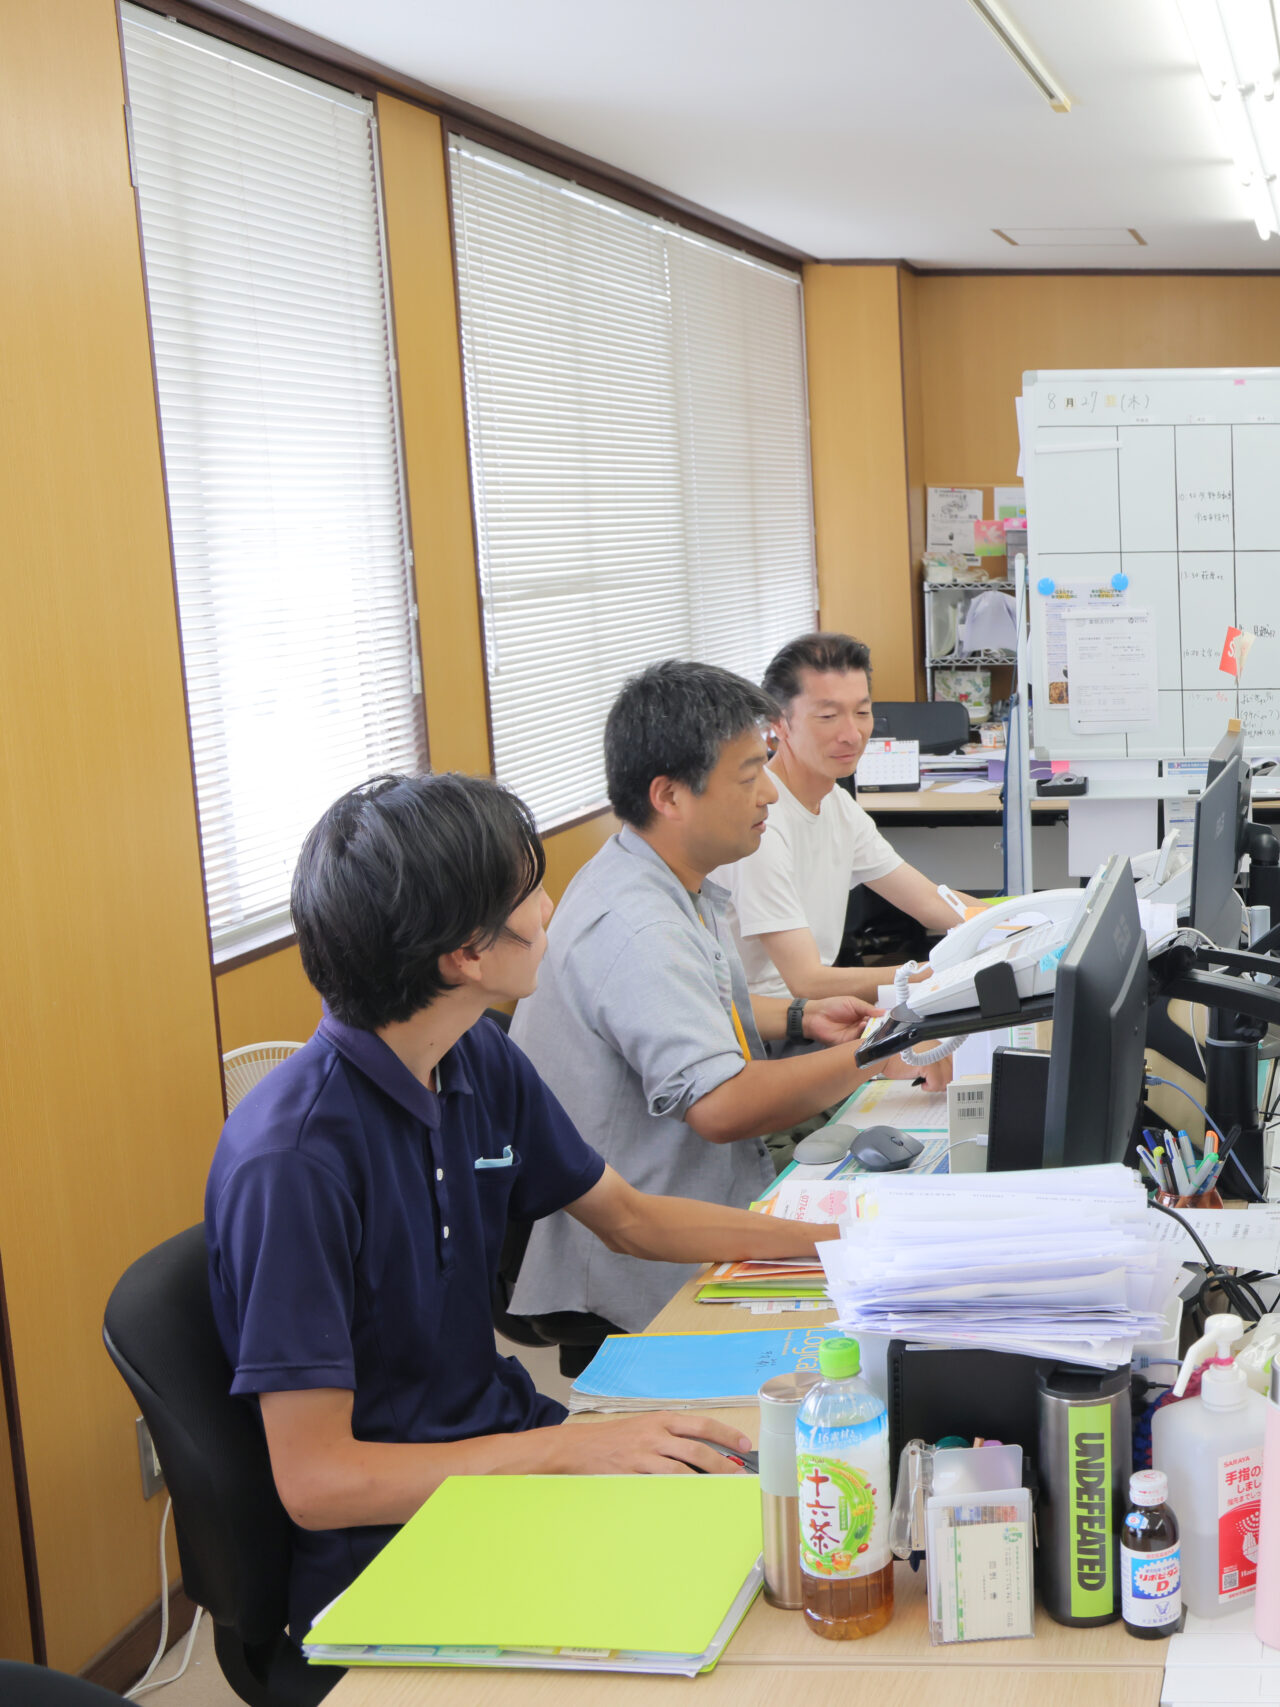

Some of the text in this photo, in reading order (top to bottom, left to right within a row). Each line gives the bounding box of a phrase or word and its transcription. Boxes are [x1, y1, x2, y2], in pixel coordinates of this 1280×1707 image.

[1224, 1456, 1251, 1468] SARAYA
[1225, 1464, 1263, 1486] 手指の
[1236, 1478, 1262, 1494] しまし
[806, 1468, 842, 1555] 十六茶
[1075, 1432, 1107, 1592] UNDEFEATED
[1139, 1568, 1179, 1582] リポビタン
[1156, 1581, 1169, 1592] D
